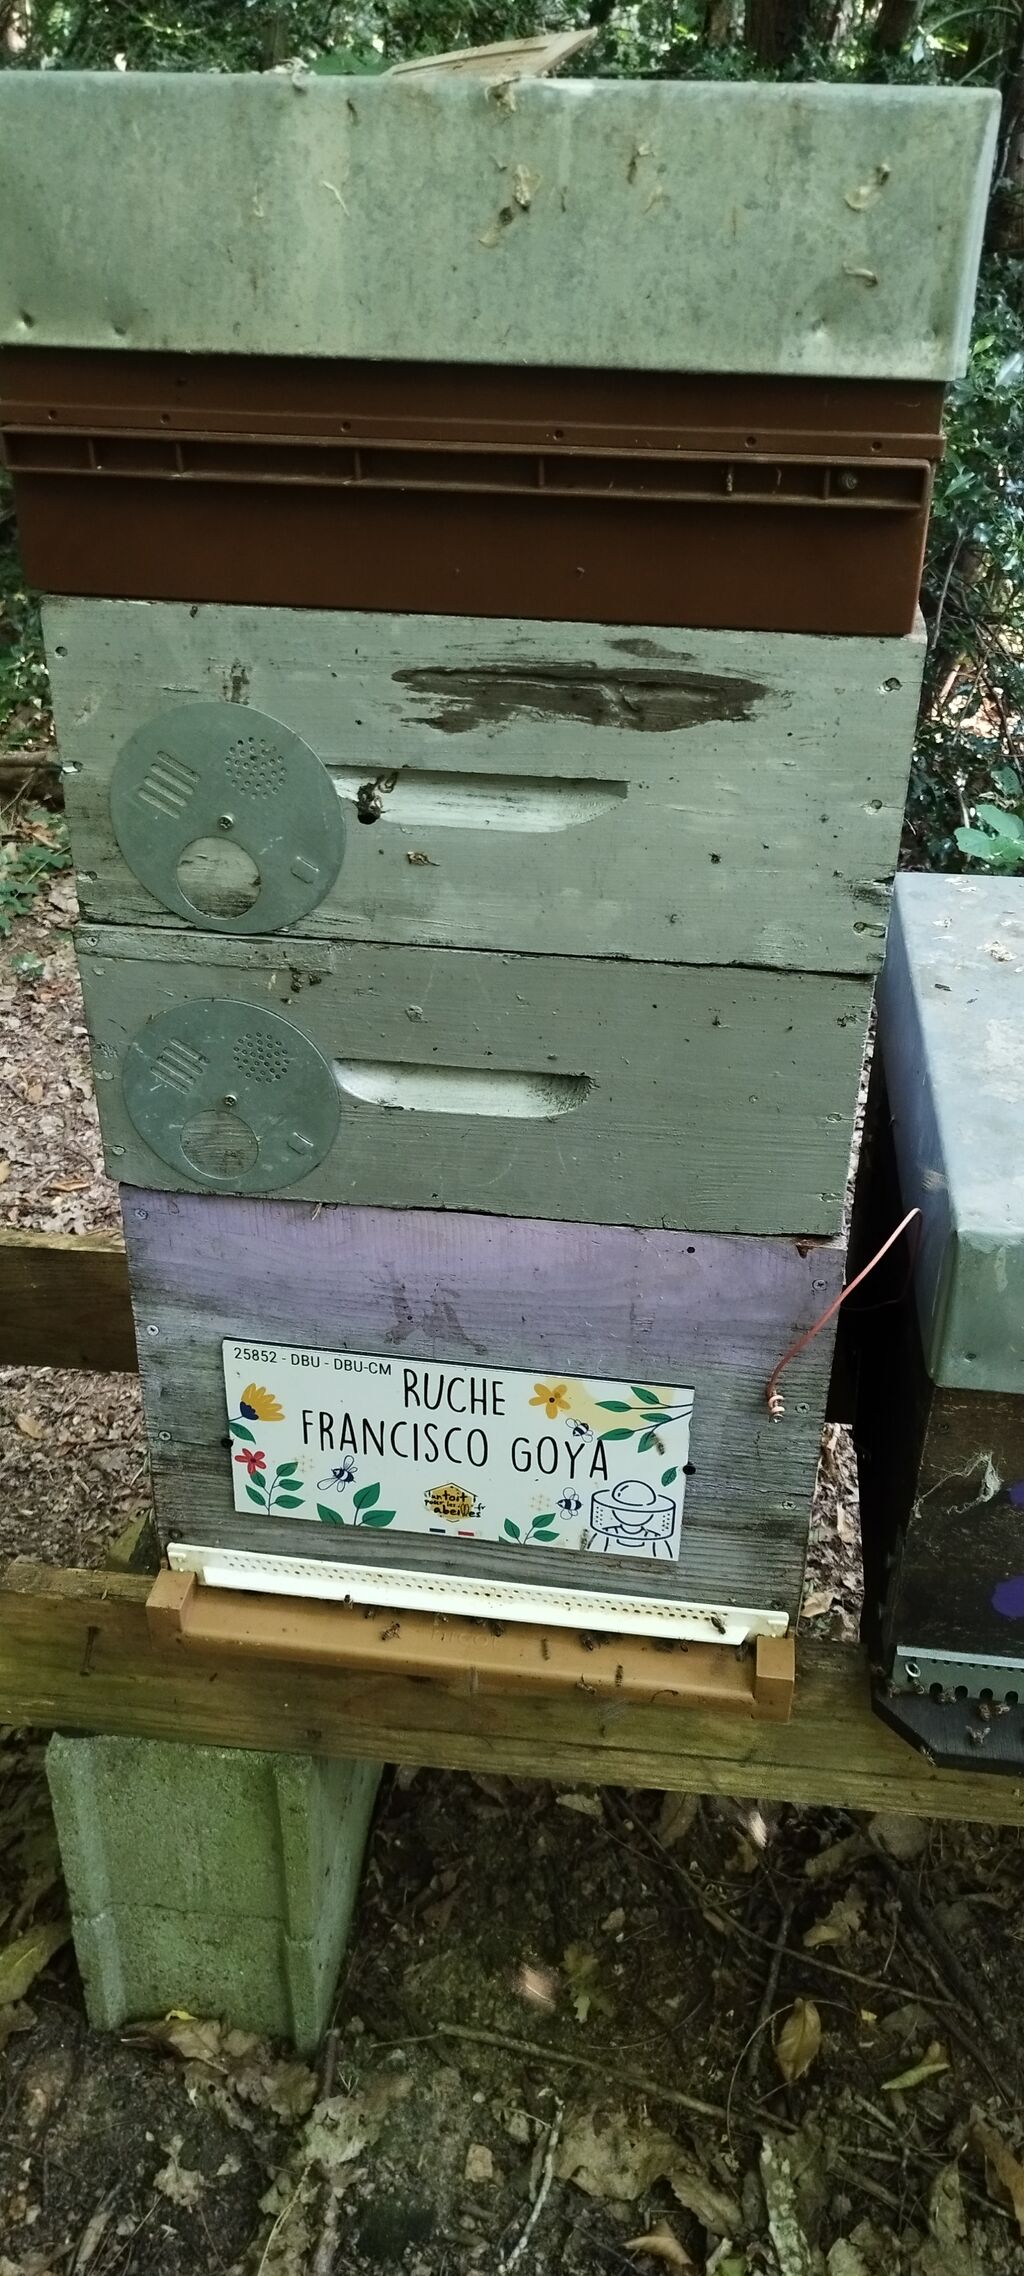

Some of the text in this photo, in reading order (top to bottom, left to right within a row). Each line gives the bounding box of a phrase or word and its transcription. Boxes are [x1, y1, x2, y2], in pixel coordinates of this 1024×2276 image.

[233, 1347, 278, 1364] 25852
[291, 1353, 320, 1368] DBU
[333, 1358, 392, 1376] DBU-CM
[403, 1368, 506, 1416] RUCHE
[302, 1409, 608, 1481] FRANCISCO GOYA
[442, 1490, 468, 1502] toit
[433, 1504, 481, 1518] abeilles
